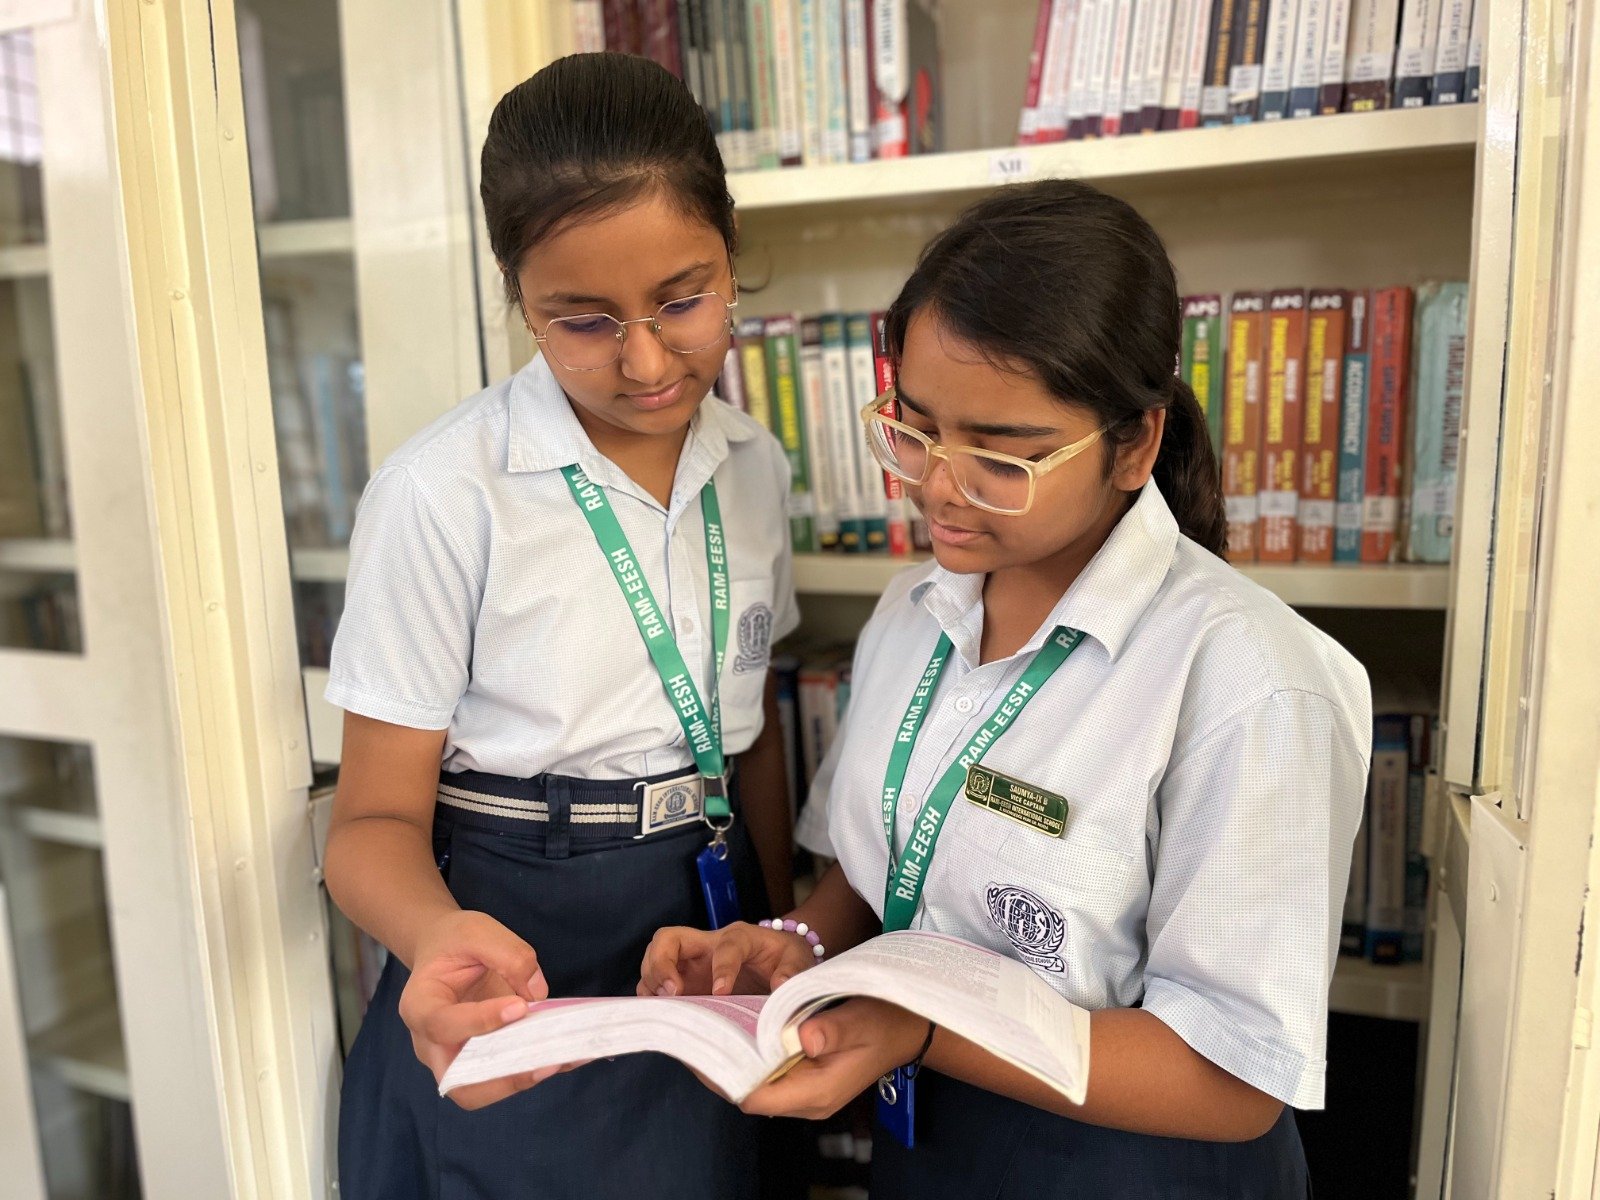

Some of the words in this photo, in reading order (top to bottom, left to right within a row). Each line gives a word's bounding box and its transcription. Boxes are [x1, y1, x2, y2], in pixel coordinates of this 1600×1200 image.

[1271, 294, 1303, 309] APC
[1310, 295, 1343, 309] APC
[1342, 360, 1364, 456] ACCOUNTANCY
[610, 546, 665, 641] RAM-EESH
[708, 522, 728, 611] RAM-EESH
[668, 672, 714, 754] RAM-EESH
[897, 656, 943, 744] RAM-EESH
[958, 680, 1034, 770] RAM-EESH
[1010, 793, 1023, 804] VICE
[1022, 799, 1045, 812] CAPTAIN
[1011, 804, 1044, 823] INTERNATIONAL
[1043, 817, 1061, 830] SCHOOL
[895, 805, 942, 902] RAM-EESH
